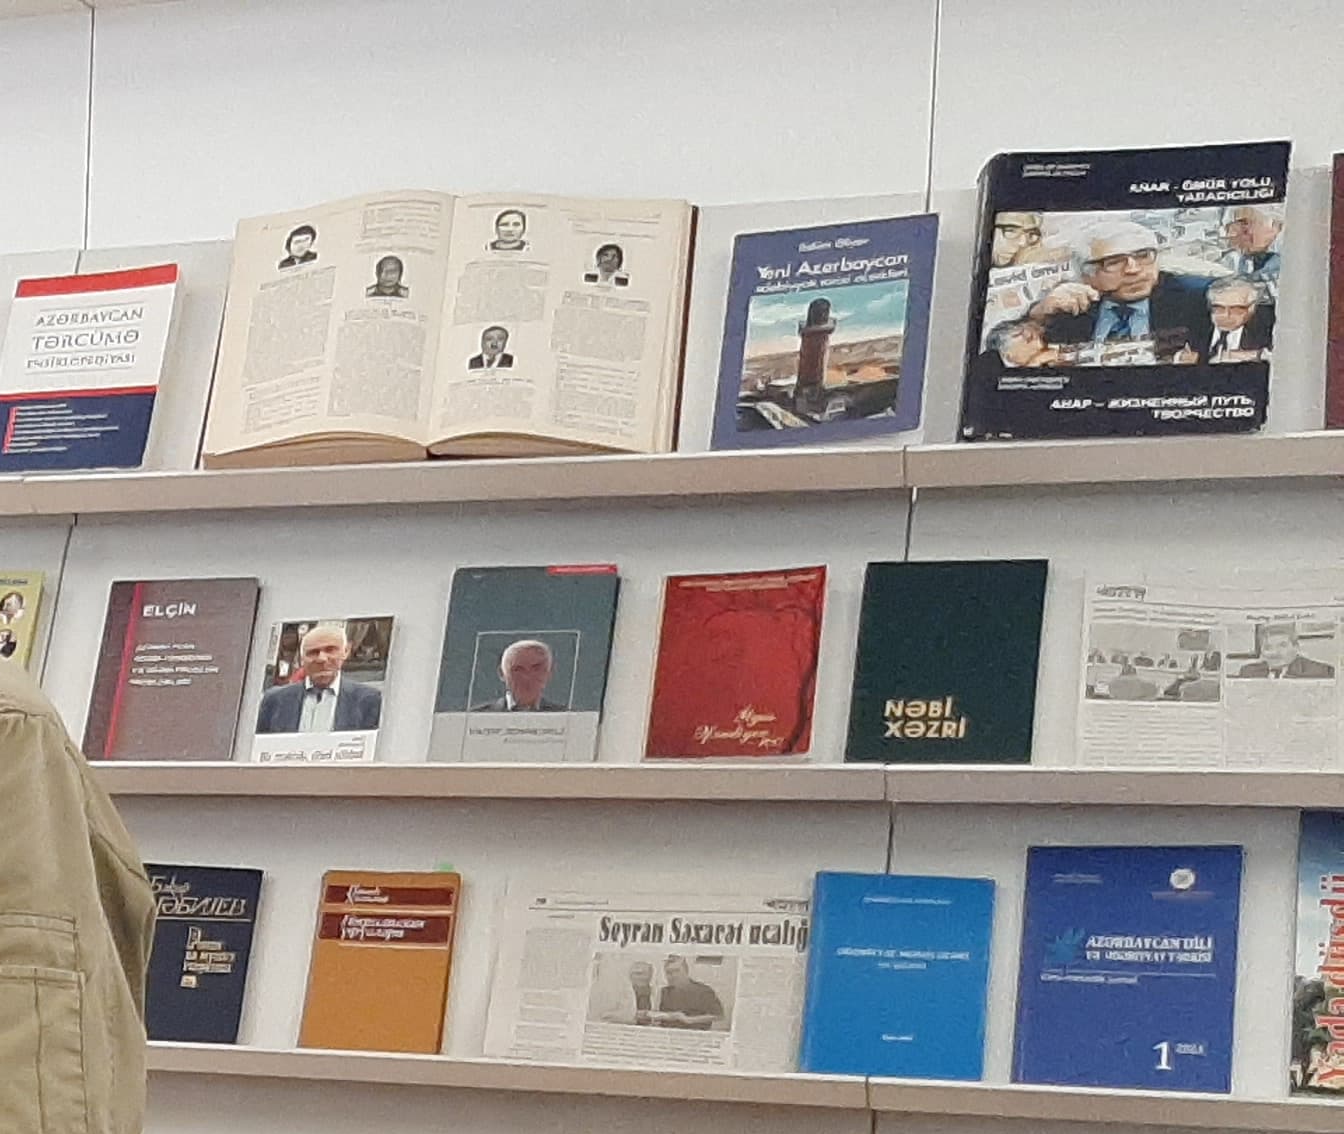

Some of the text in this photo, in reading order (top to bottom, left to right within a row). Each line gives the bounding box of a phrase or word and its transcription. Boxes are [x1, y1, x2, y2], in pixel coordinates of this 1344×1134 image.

[36, 307, 144, 327] AZƏRBAYCAN
[31, 328, 140, 351] TƏRCÜMƏ
[142, 601, 198, 619] ELÇİN
[883, 695, 953, 718] NƏBİ
[883, 715, 968, 738] XƏZRİ
[599, 915, 665, 949] Seyran
[1152, 1041, 1173, 1071] 1
